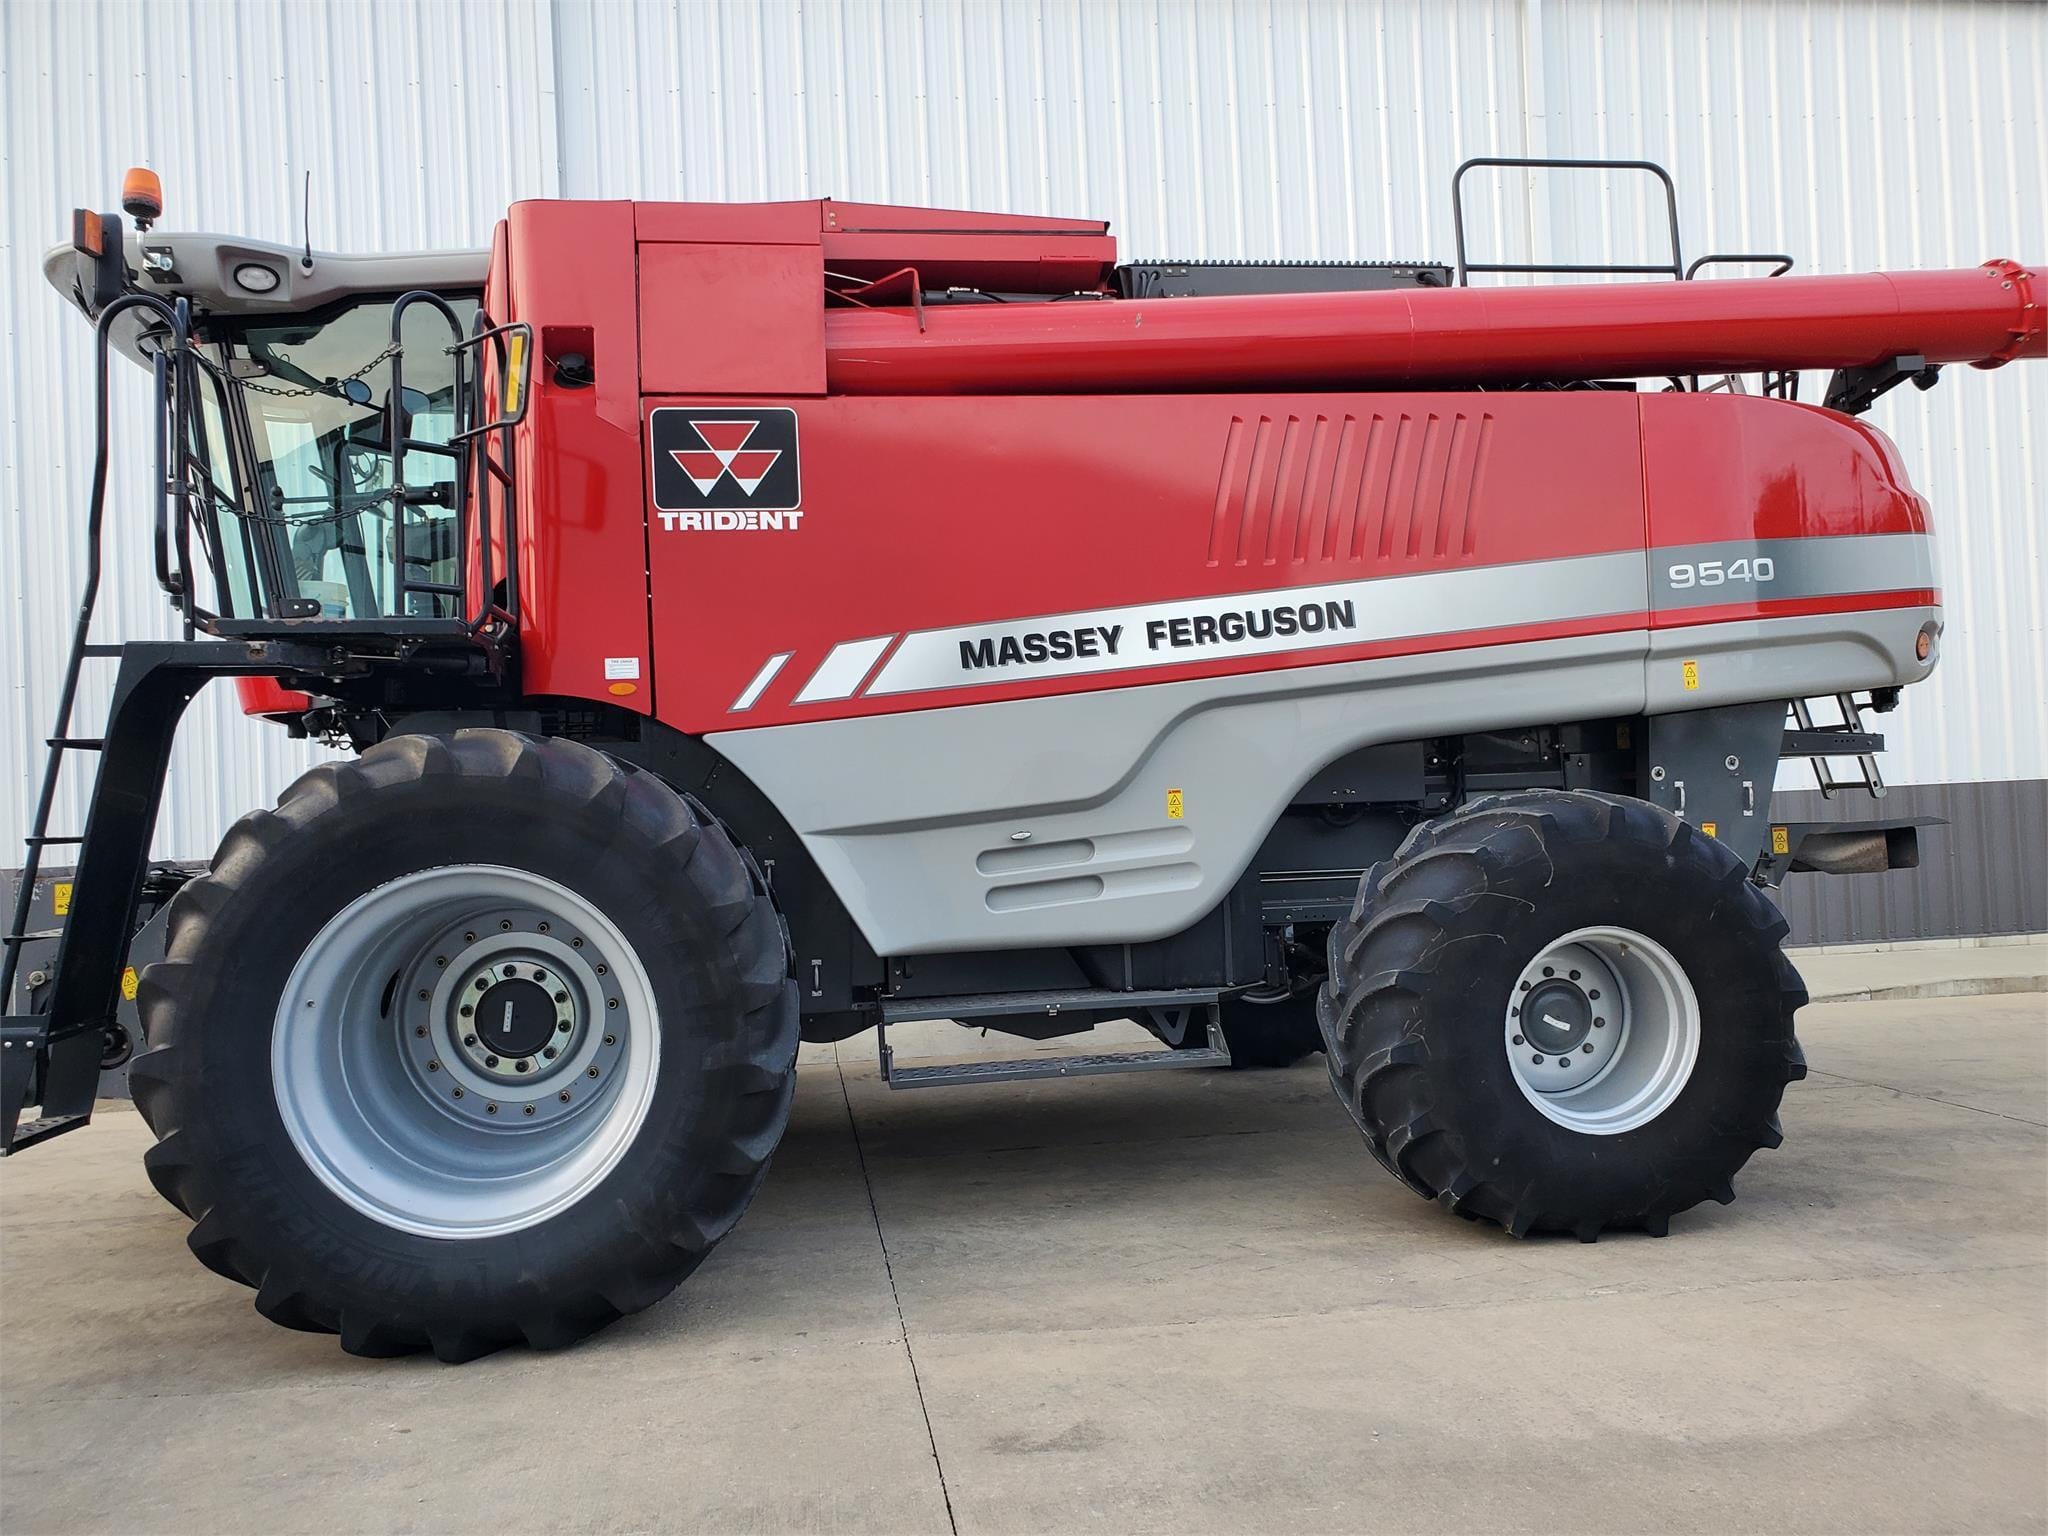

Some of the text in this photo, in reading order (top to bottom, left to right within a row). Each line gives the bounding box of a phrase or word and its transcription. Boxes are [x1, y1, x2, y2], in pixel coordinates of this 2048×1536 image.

[657, 511, 804, 531] TRIDENT
[1668, 557, 1775, 589] 9540
[959, 599, 1356, 671] MASSEY FERGUSON
